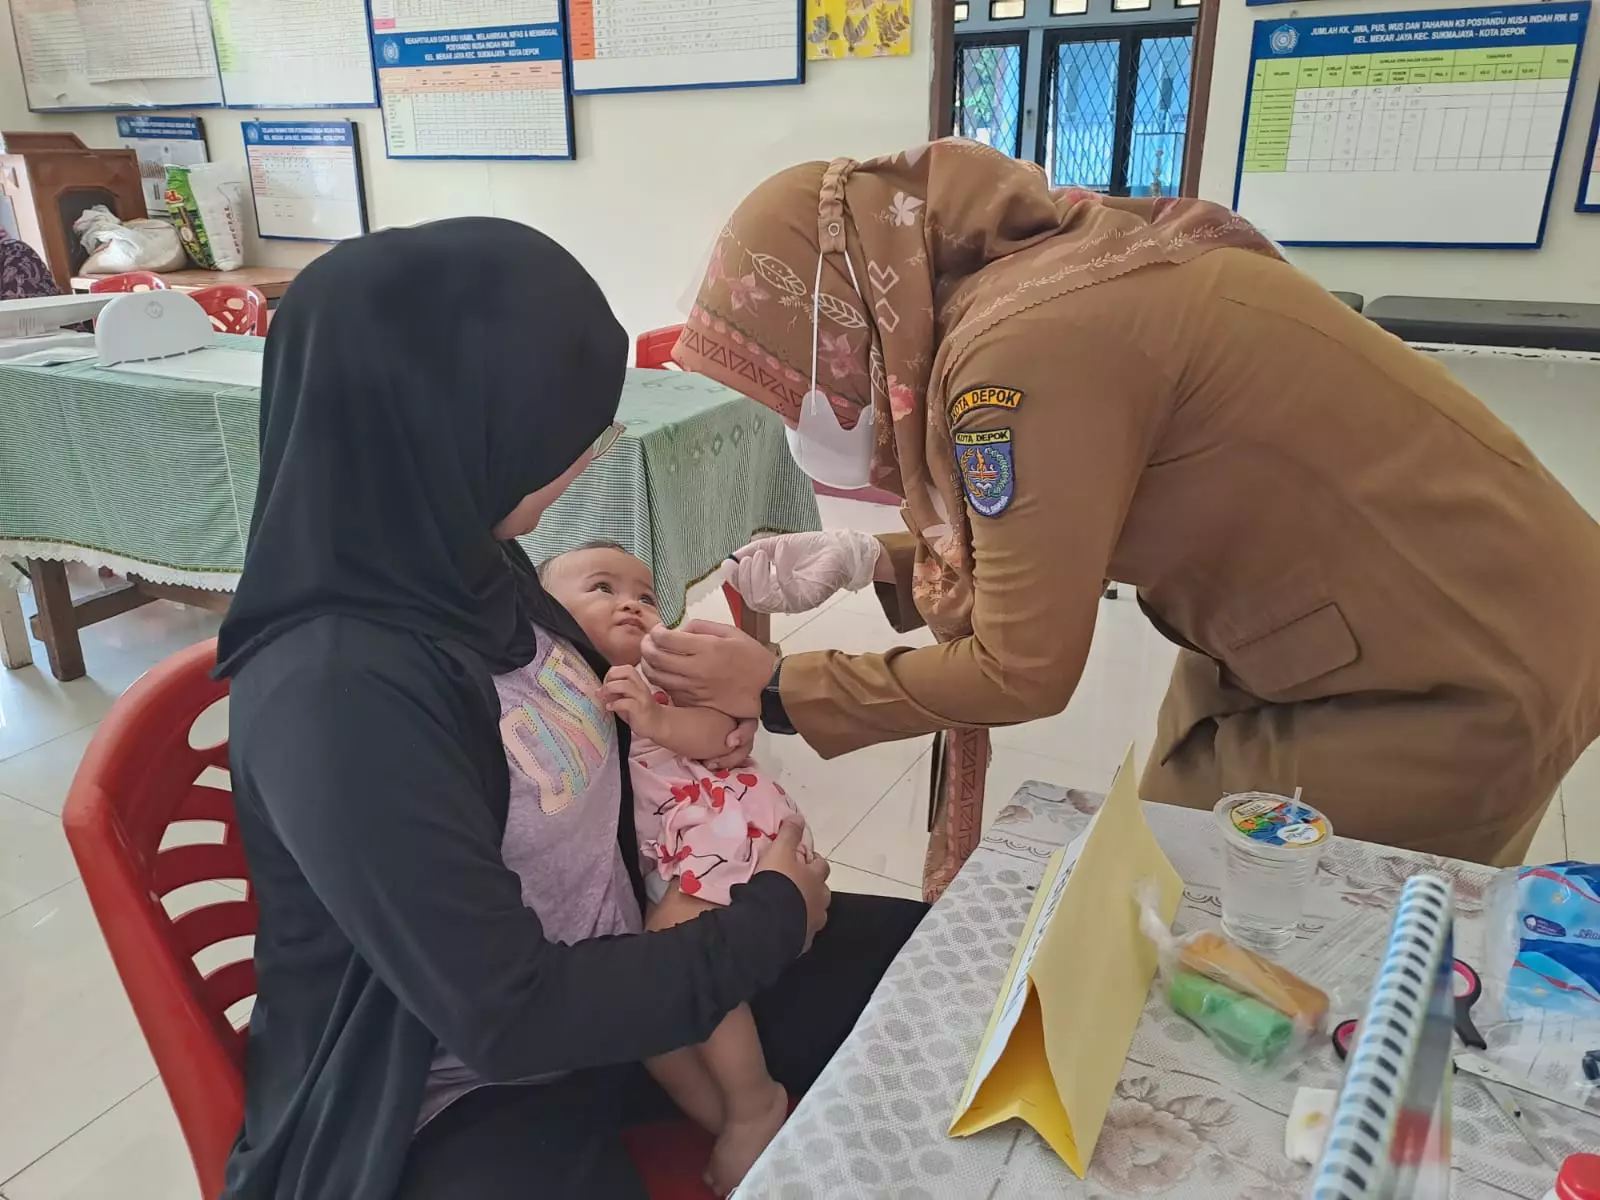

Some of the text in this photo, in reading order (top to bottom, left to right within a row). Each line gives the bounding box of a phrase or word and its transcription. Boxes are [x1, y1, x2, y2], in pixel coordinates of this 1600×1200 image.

[1405, 21, 1421, 30] DAN
[1422, 19, 1454, 29] TAHAPAN
[1455, 18, 1466, 28] KS
[1507, 15, 1528, 25] NUSA
[1529, 14, 1554, 24] INDAH
[1370, 33, 1395, 43] MEKAR
[1479, 28, 1499, 38] KOTA
[1500, 26, 1527, 36] DEPOK
[952, 389, 1018, 419] KOTA DEPOK
[957, 430, 1009, 443] KOTA DEPOK
